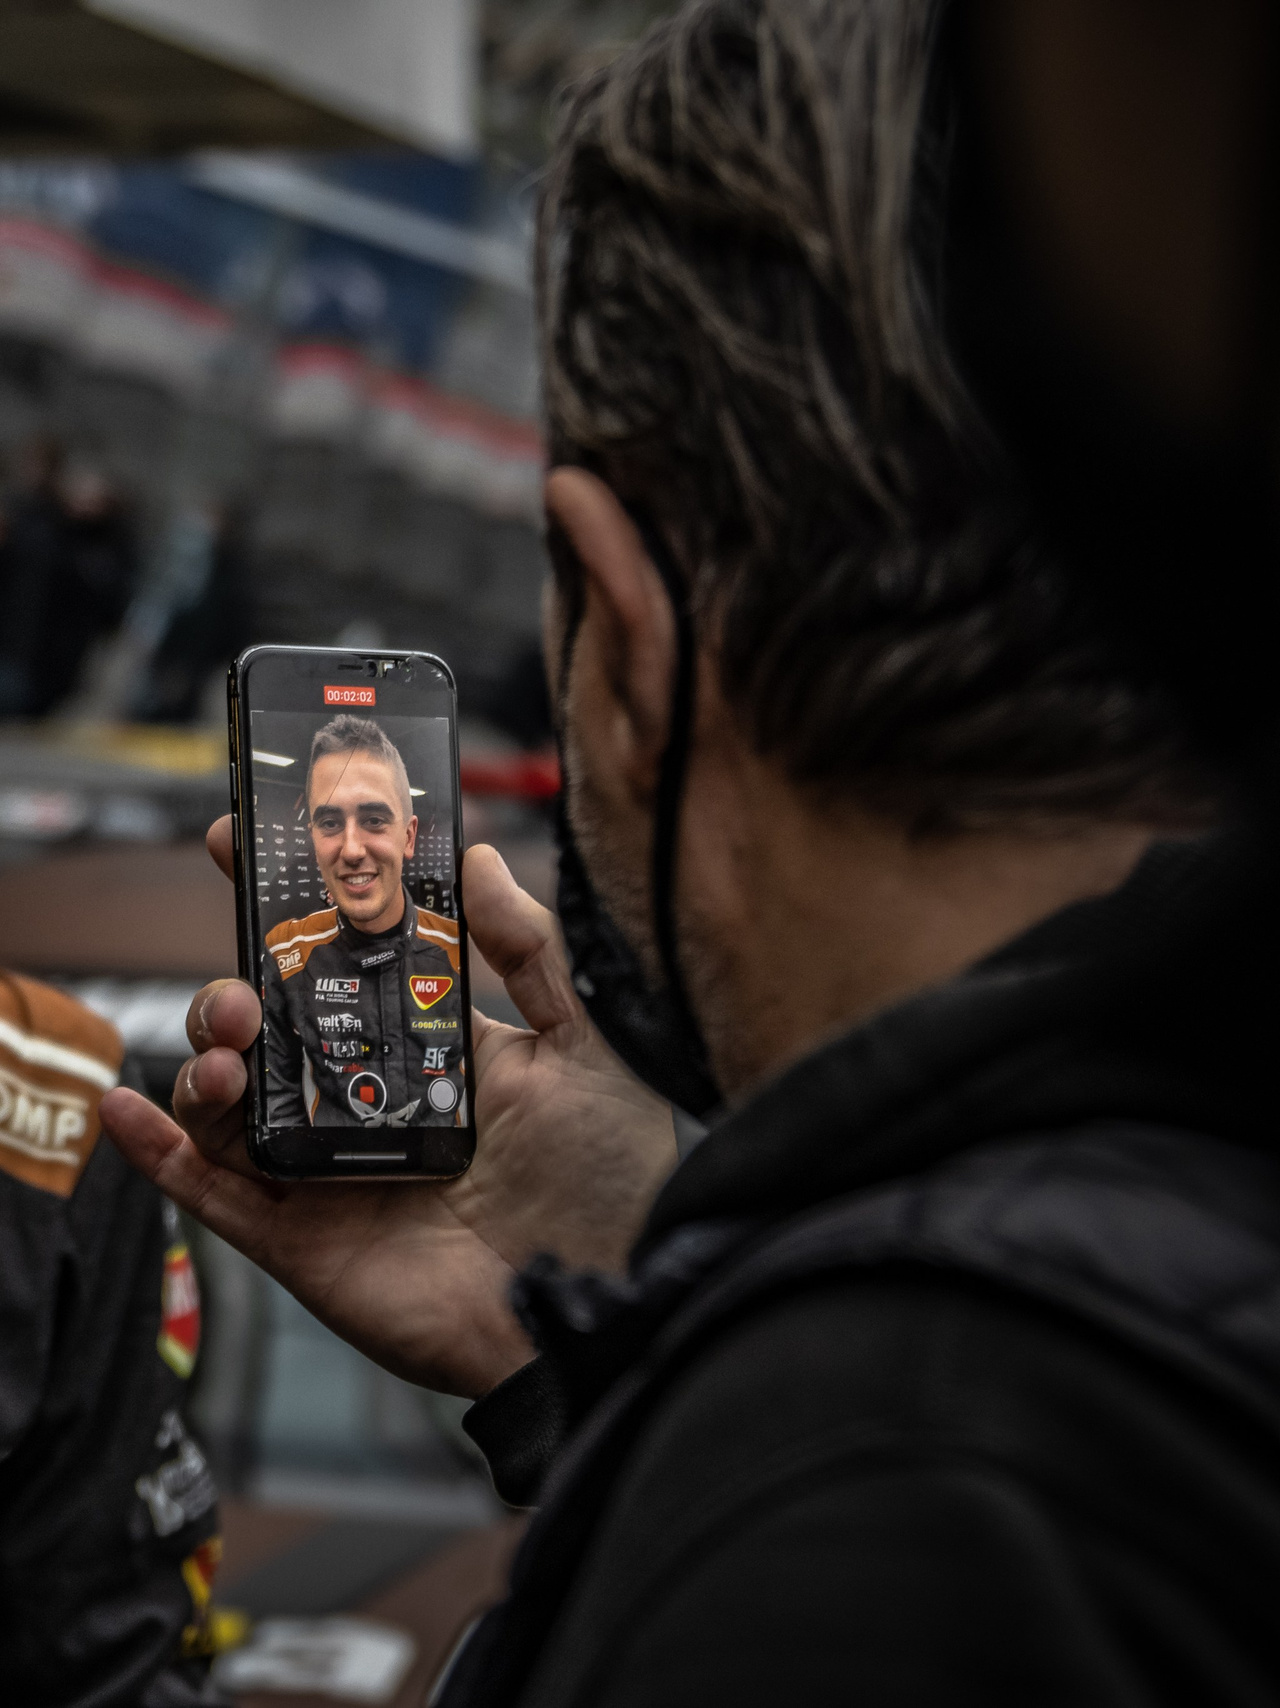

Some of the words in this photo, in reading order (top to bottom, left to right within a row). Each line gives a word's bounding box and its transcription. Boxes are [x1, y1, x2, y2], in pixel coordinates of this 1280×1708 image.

[327, 690, 372, 703] 00:02:02
[277, 951, 301, 970] OMP
[315, 978, 360, 993] WTCR
[415, 980, 438, 993] MOL
[422, 1046, 452, 1070] 96
